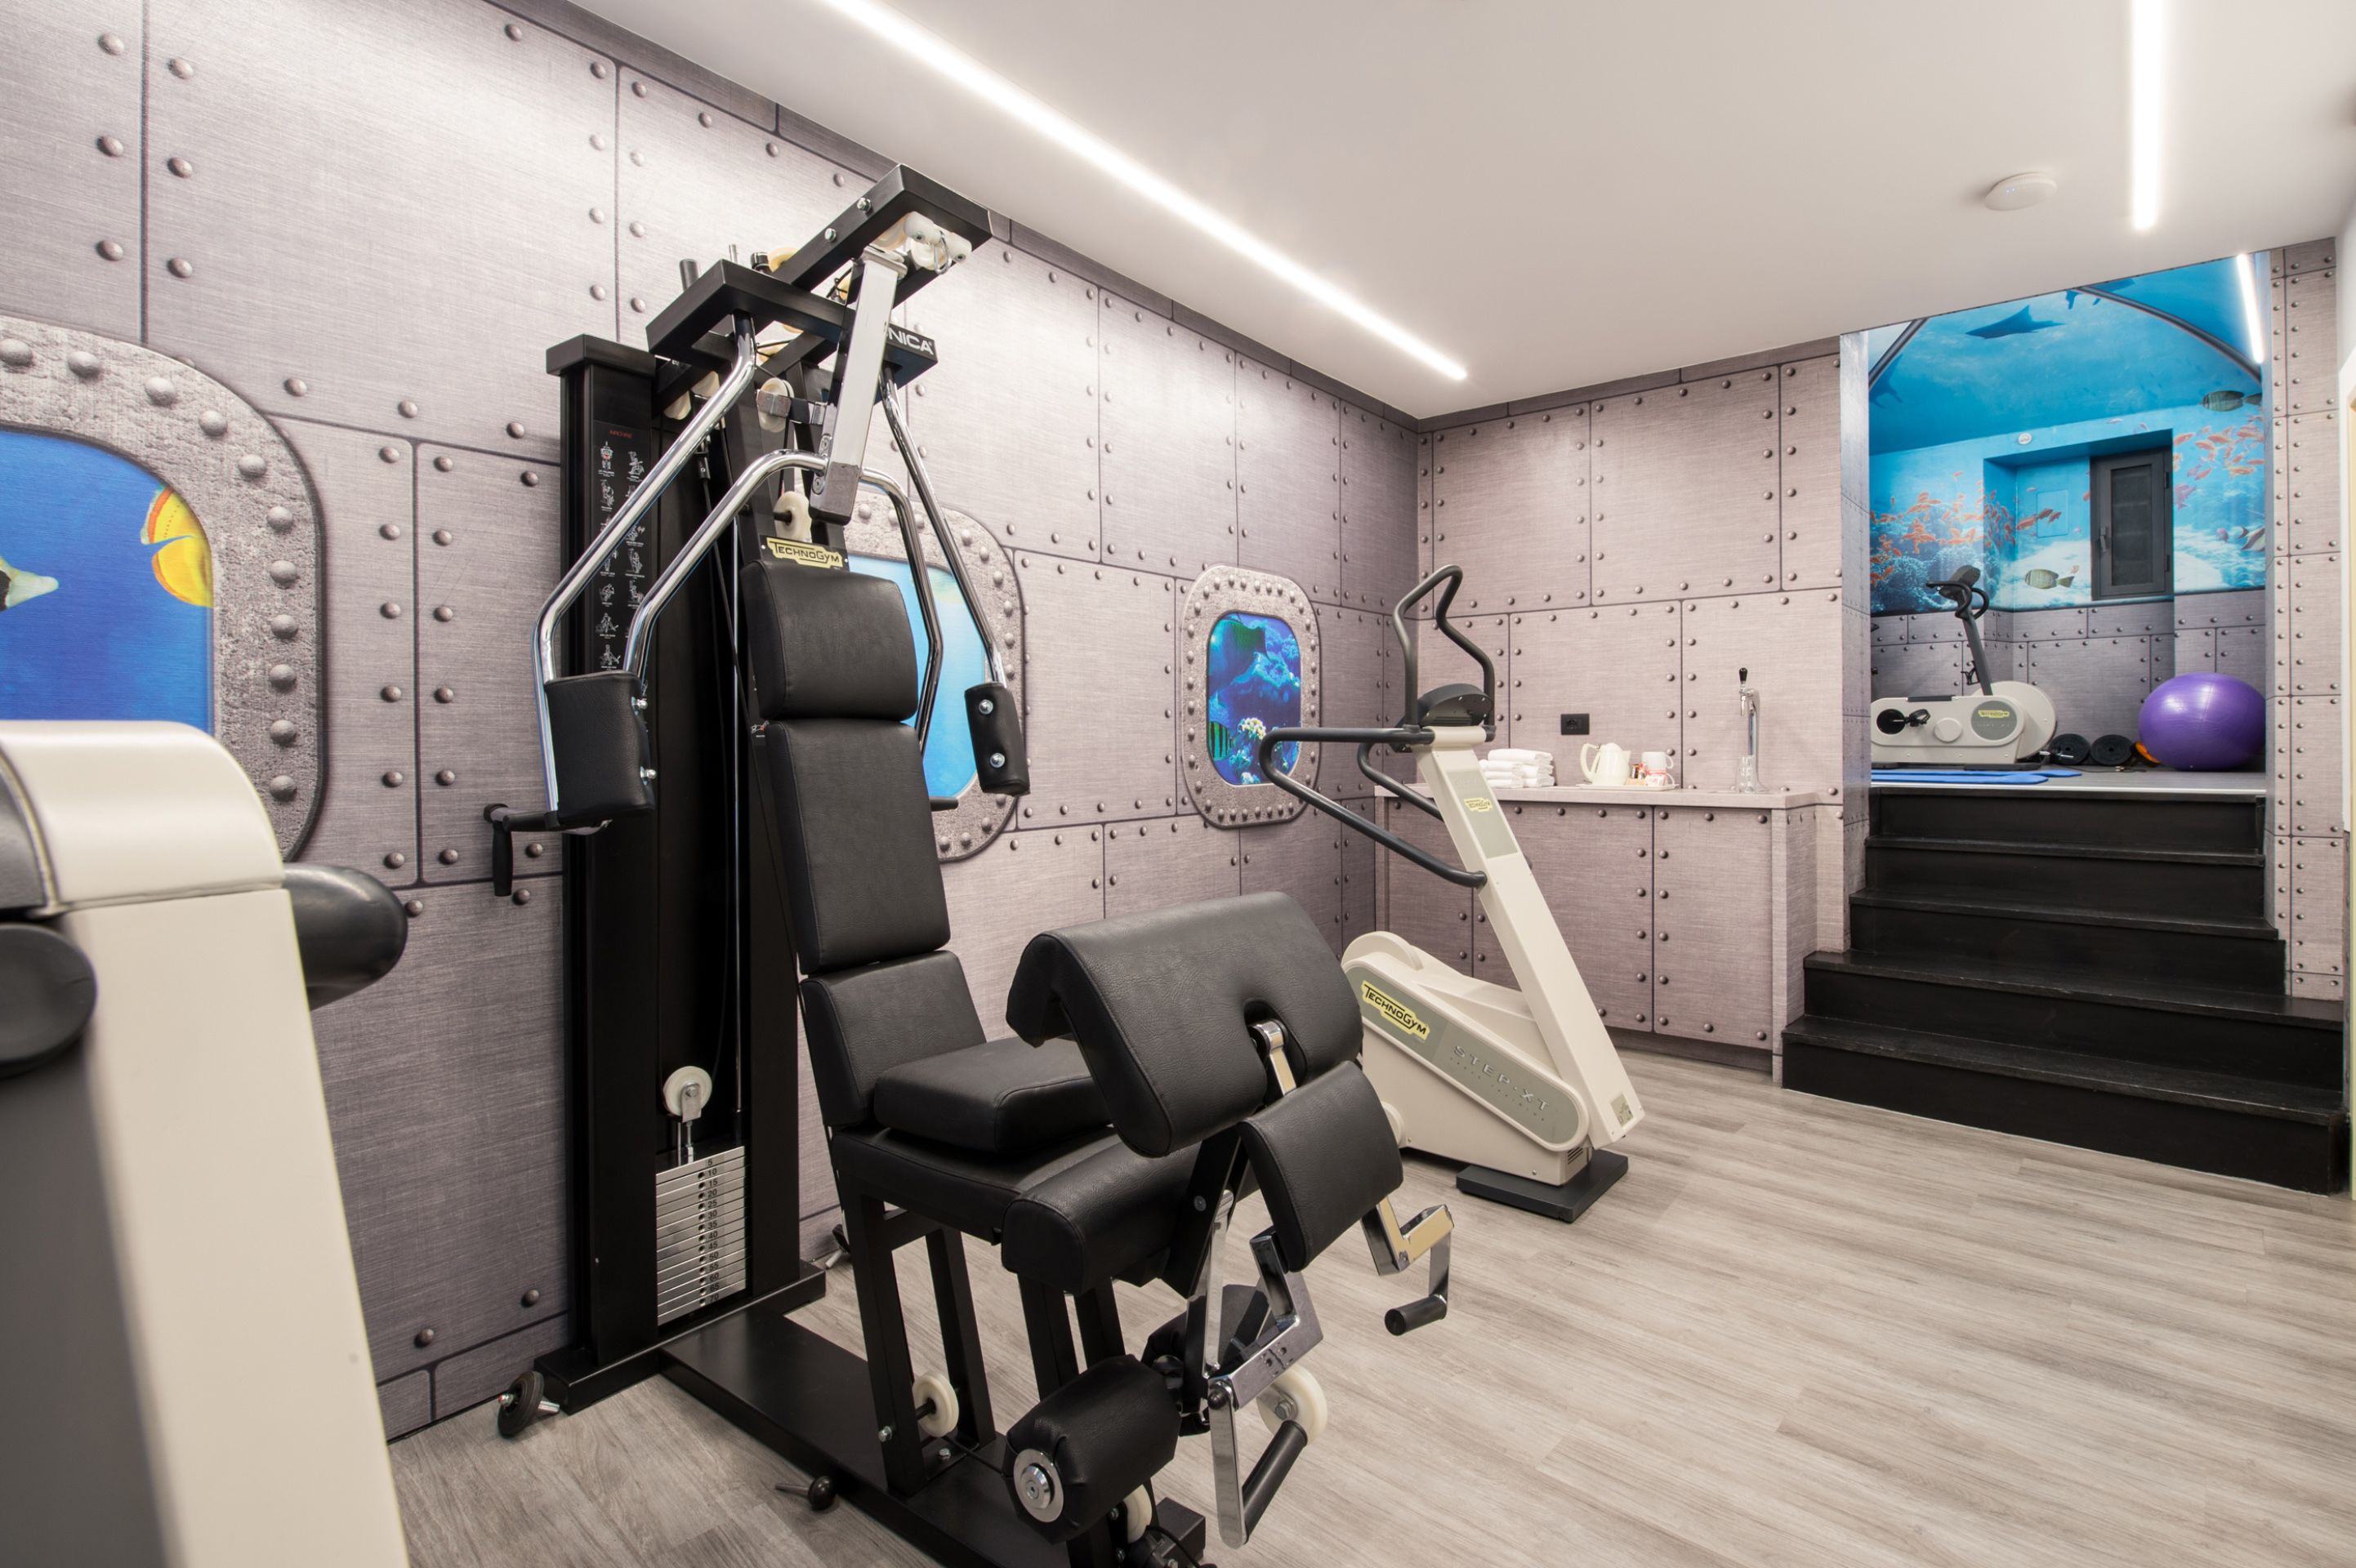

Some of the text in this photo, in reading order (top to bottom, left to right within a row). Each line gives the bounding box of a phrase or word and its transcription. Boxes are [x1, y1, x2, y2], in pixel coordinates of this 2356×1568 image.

[887, 327, 934, 355] NICA
[769, 541, 840, 564] TECHNOGYM
[1363, 983, 1426, 1035] TECHNOGYM
[707, 1168, 717, 1176] 10
[708, 1178, 718, 1187] 15
[707, 1189, 717, 1197] 20
[707, 1200, 717, 1208] 25
[707, 1209, 717, 1218] 30
[708, 1221, 718, 1229] 35
[708, 1231, 718, 1239] 40
[708, 1241, 718, 1250] 45
[709, 1251, 719, 1260] 50
[709, 1262, 719, 1271] 55
[709, 1272, 719, 1281] 60
[710, 1283, 719, 1291] 65
[710, 1293, 719, 1302] 70
